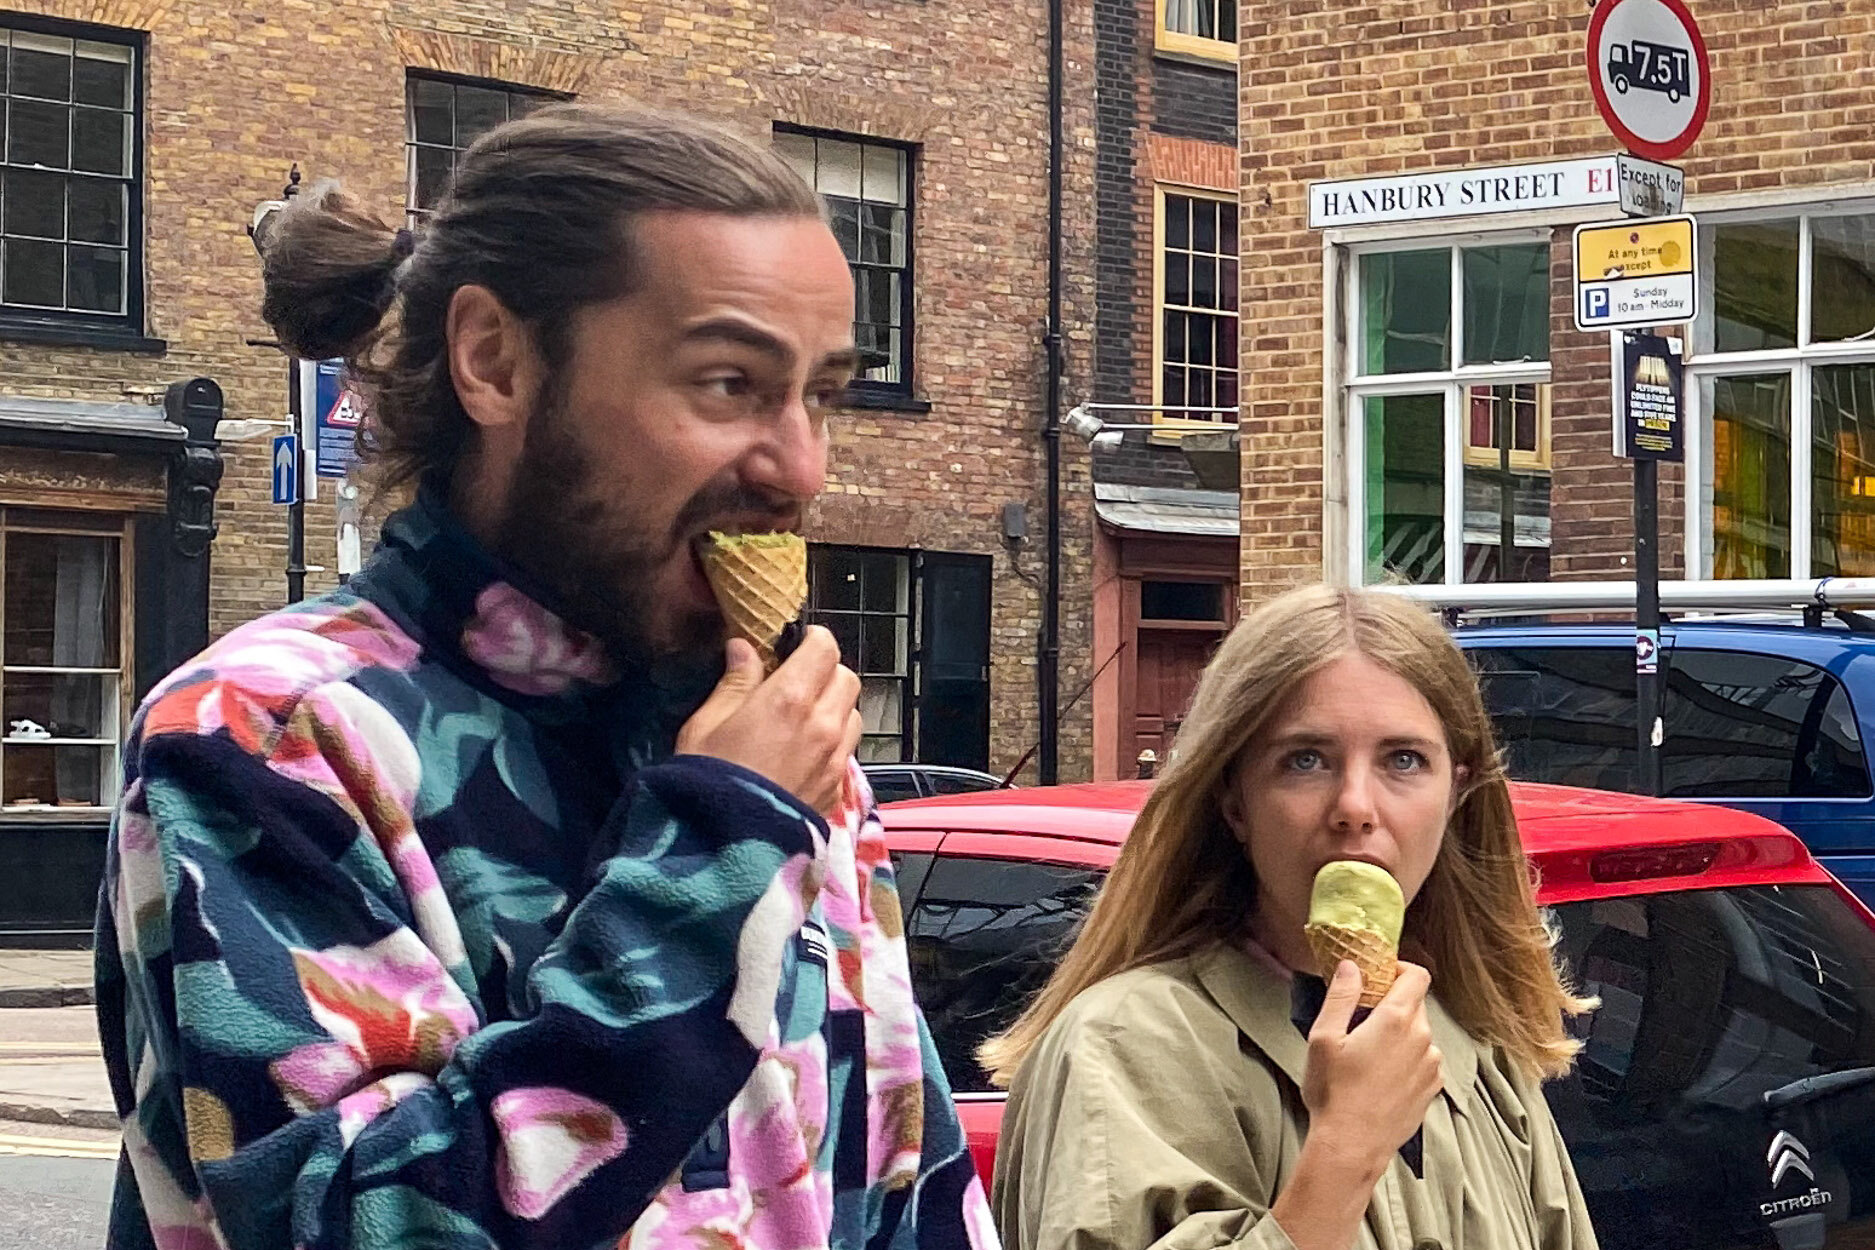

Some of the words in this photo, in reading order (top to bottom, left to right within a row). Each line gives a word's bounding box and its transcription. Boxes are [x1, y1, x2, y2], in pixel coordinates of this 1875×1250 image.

[1634, 45, 1687, 85] 7.5T
[1621, 163, 1663, 189] Except
[1666, 173, 1681, 192] for
[1323, 182, 1450, 217] HANBURY
[1460, 172, 1565, 205] STREET
[1587, 169, 1613, 193] E1
[1632, 192, 1673, 215] loang
[1608, 249, 1619, 260] At
[1622, 250, 1639, 260] any
[1633, 286, 1668, 299] Sunday
[1617, 302, 1629, 313] 10
[1630, 303, 1645, 311] am
[1651, 298, 1685, 310] Midday
